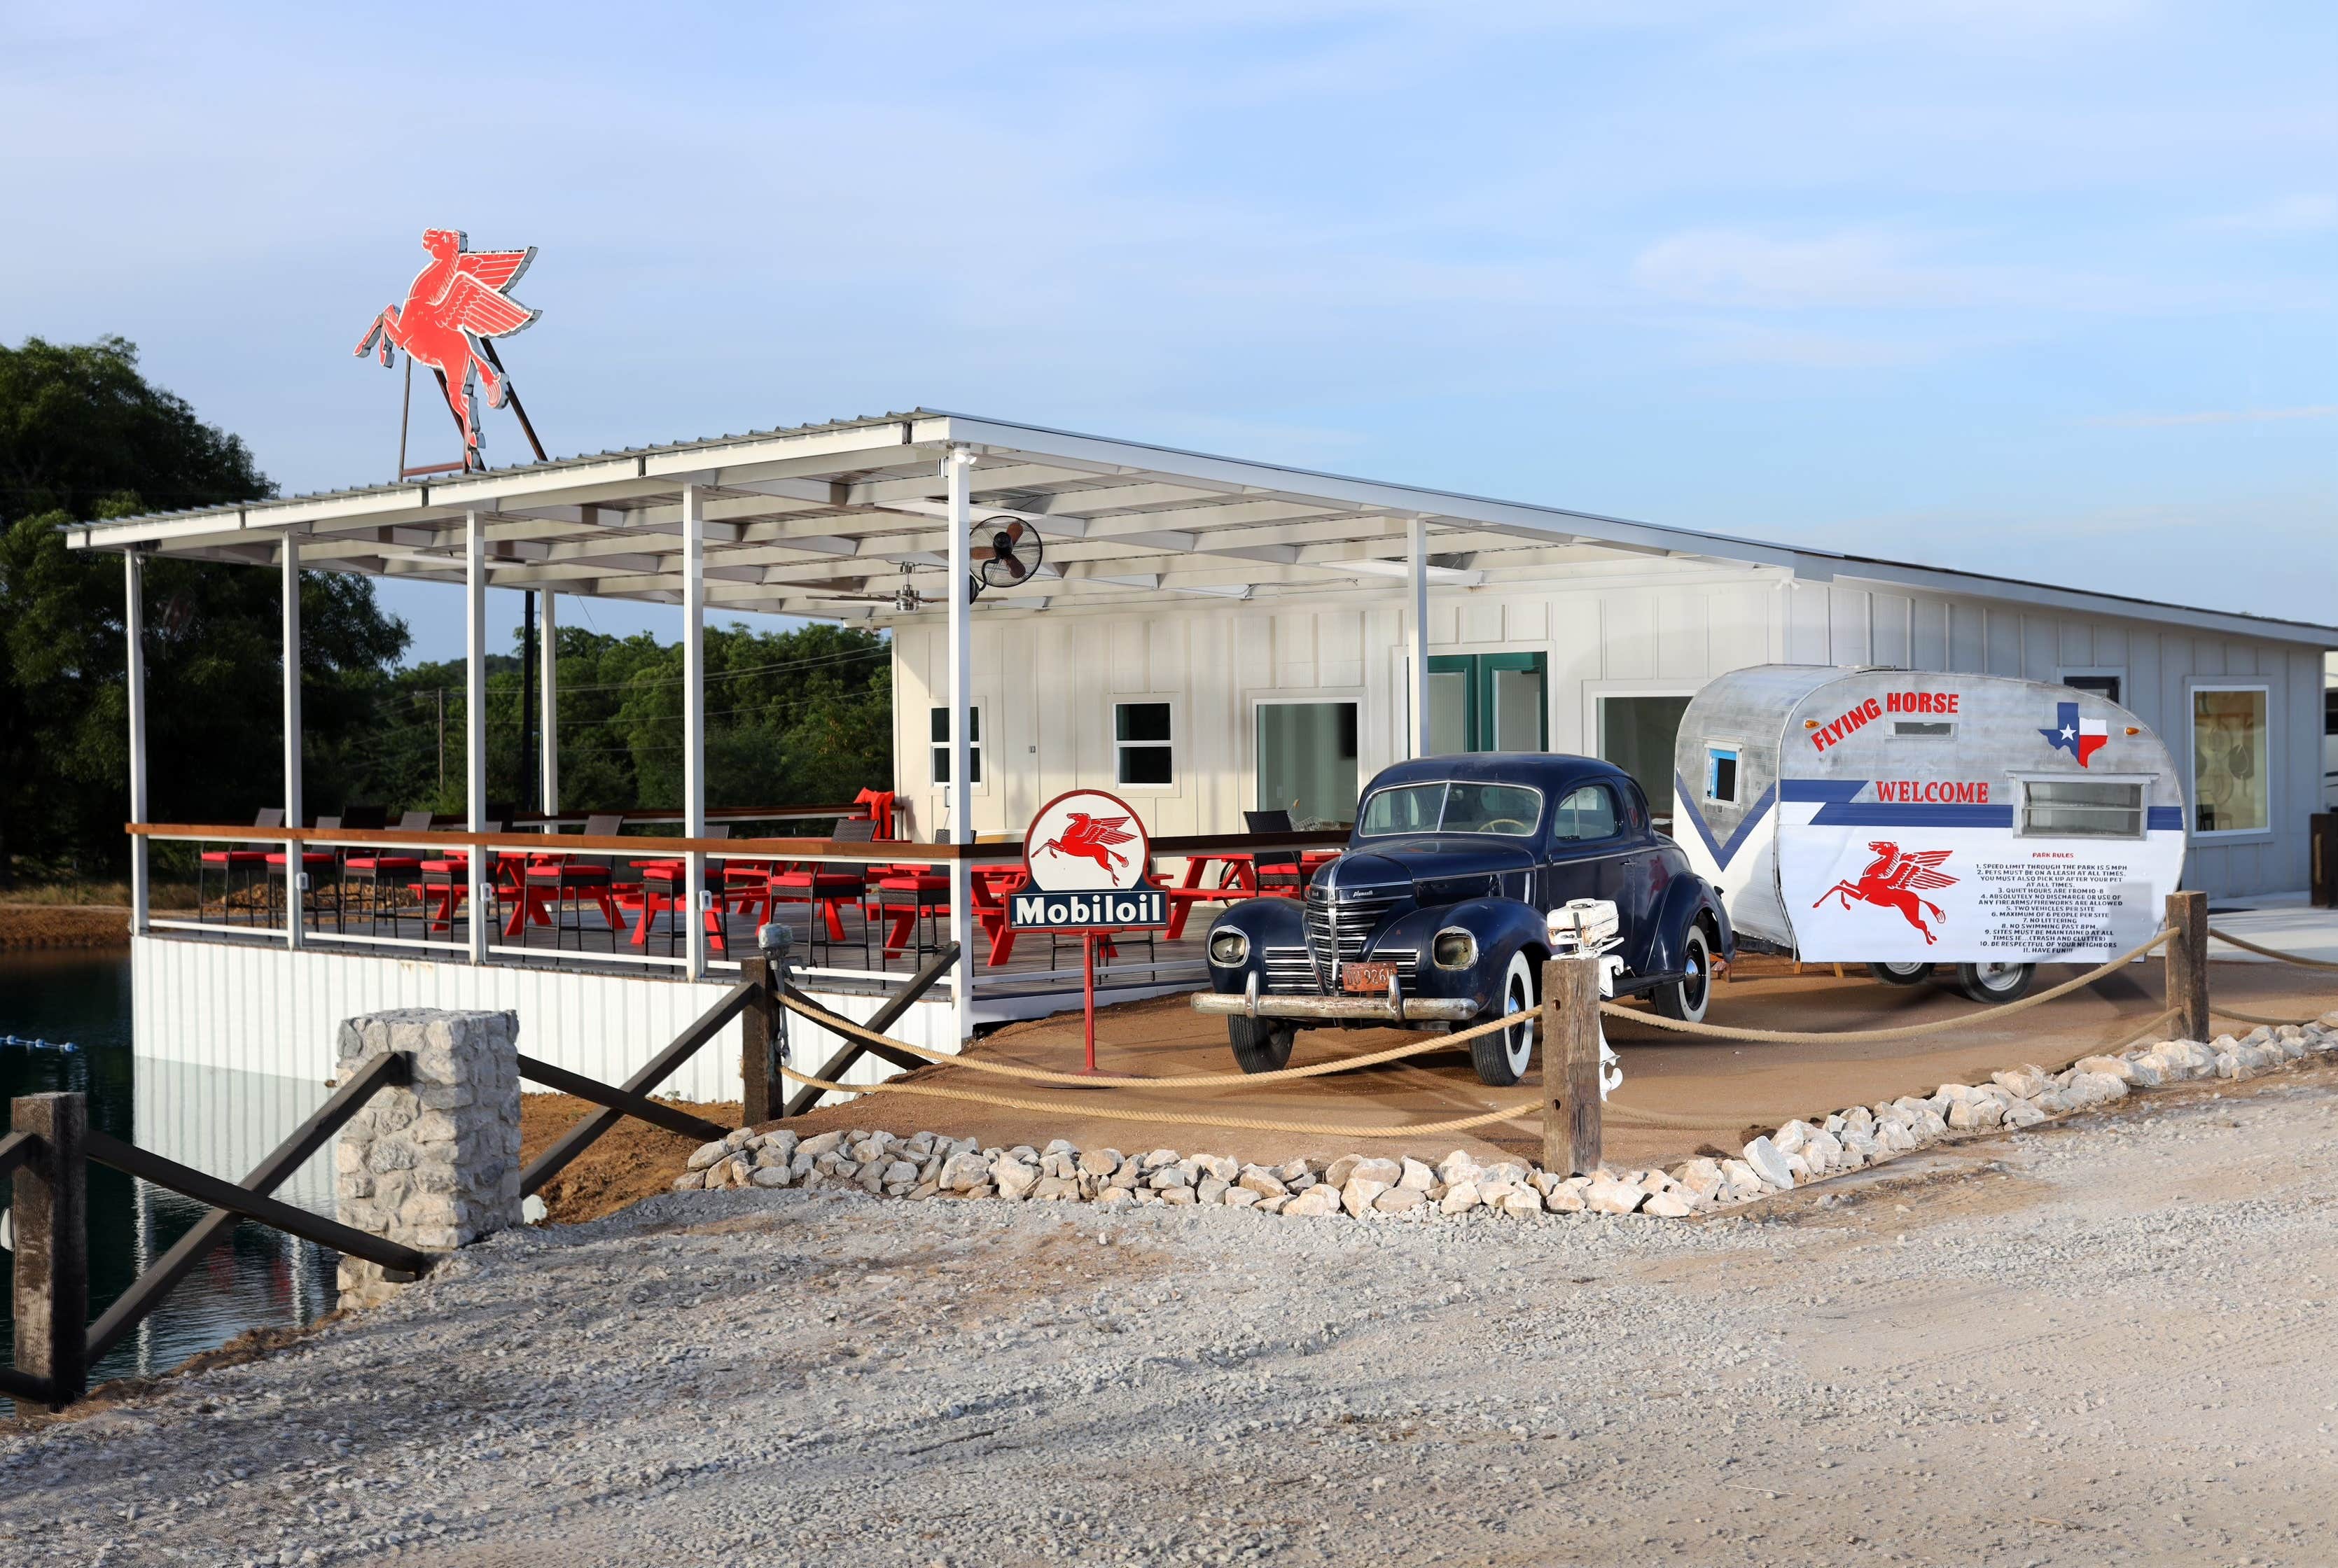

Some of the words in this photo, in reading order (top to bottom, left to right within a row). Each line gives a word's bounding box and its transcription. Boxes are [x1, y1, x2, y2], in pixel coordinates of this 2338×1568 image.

[1810, 698, 1882, 752] FLYING
[1886, 692, 1959, 713] HORSE
[1875, 780, 1989, 804] WELCOME
[1016, 894, 1160, 924] Mobiloil
